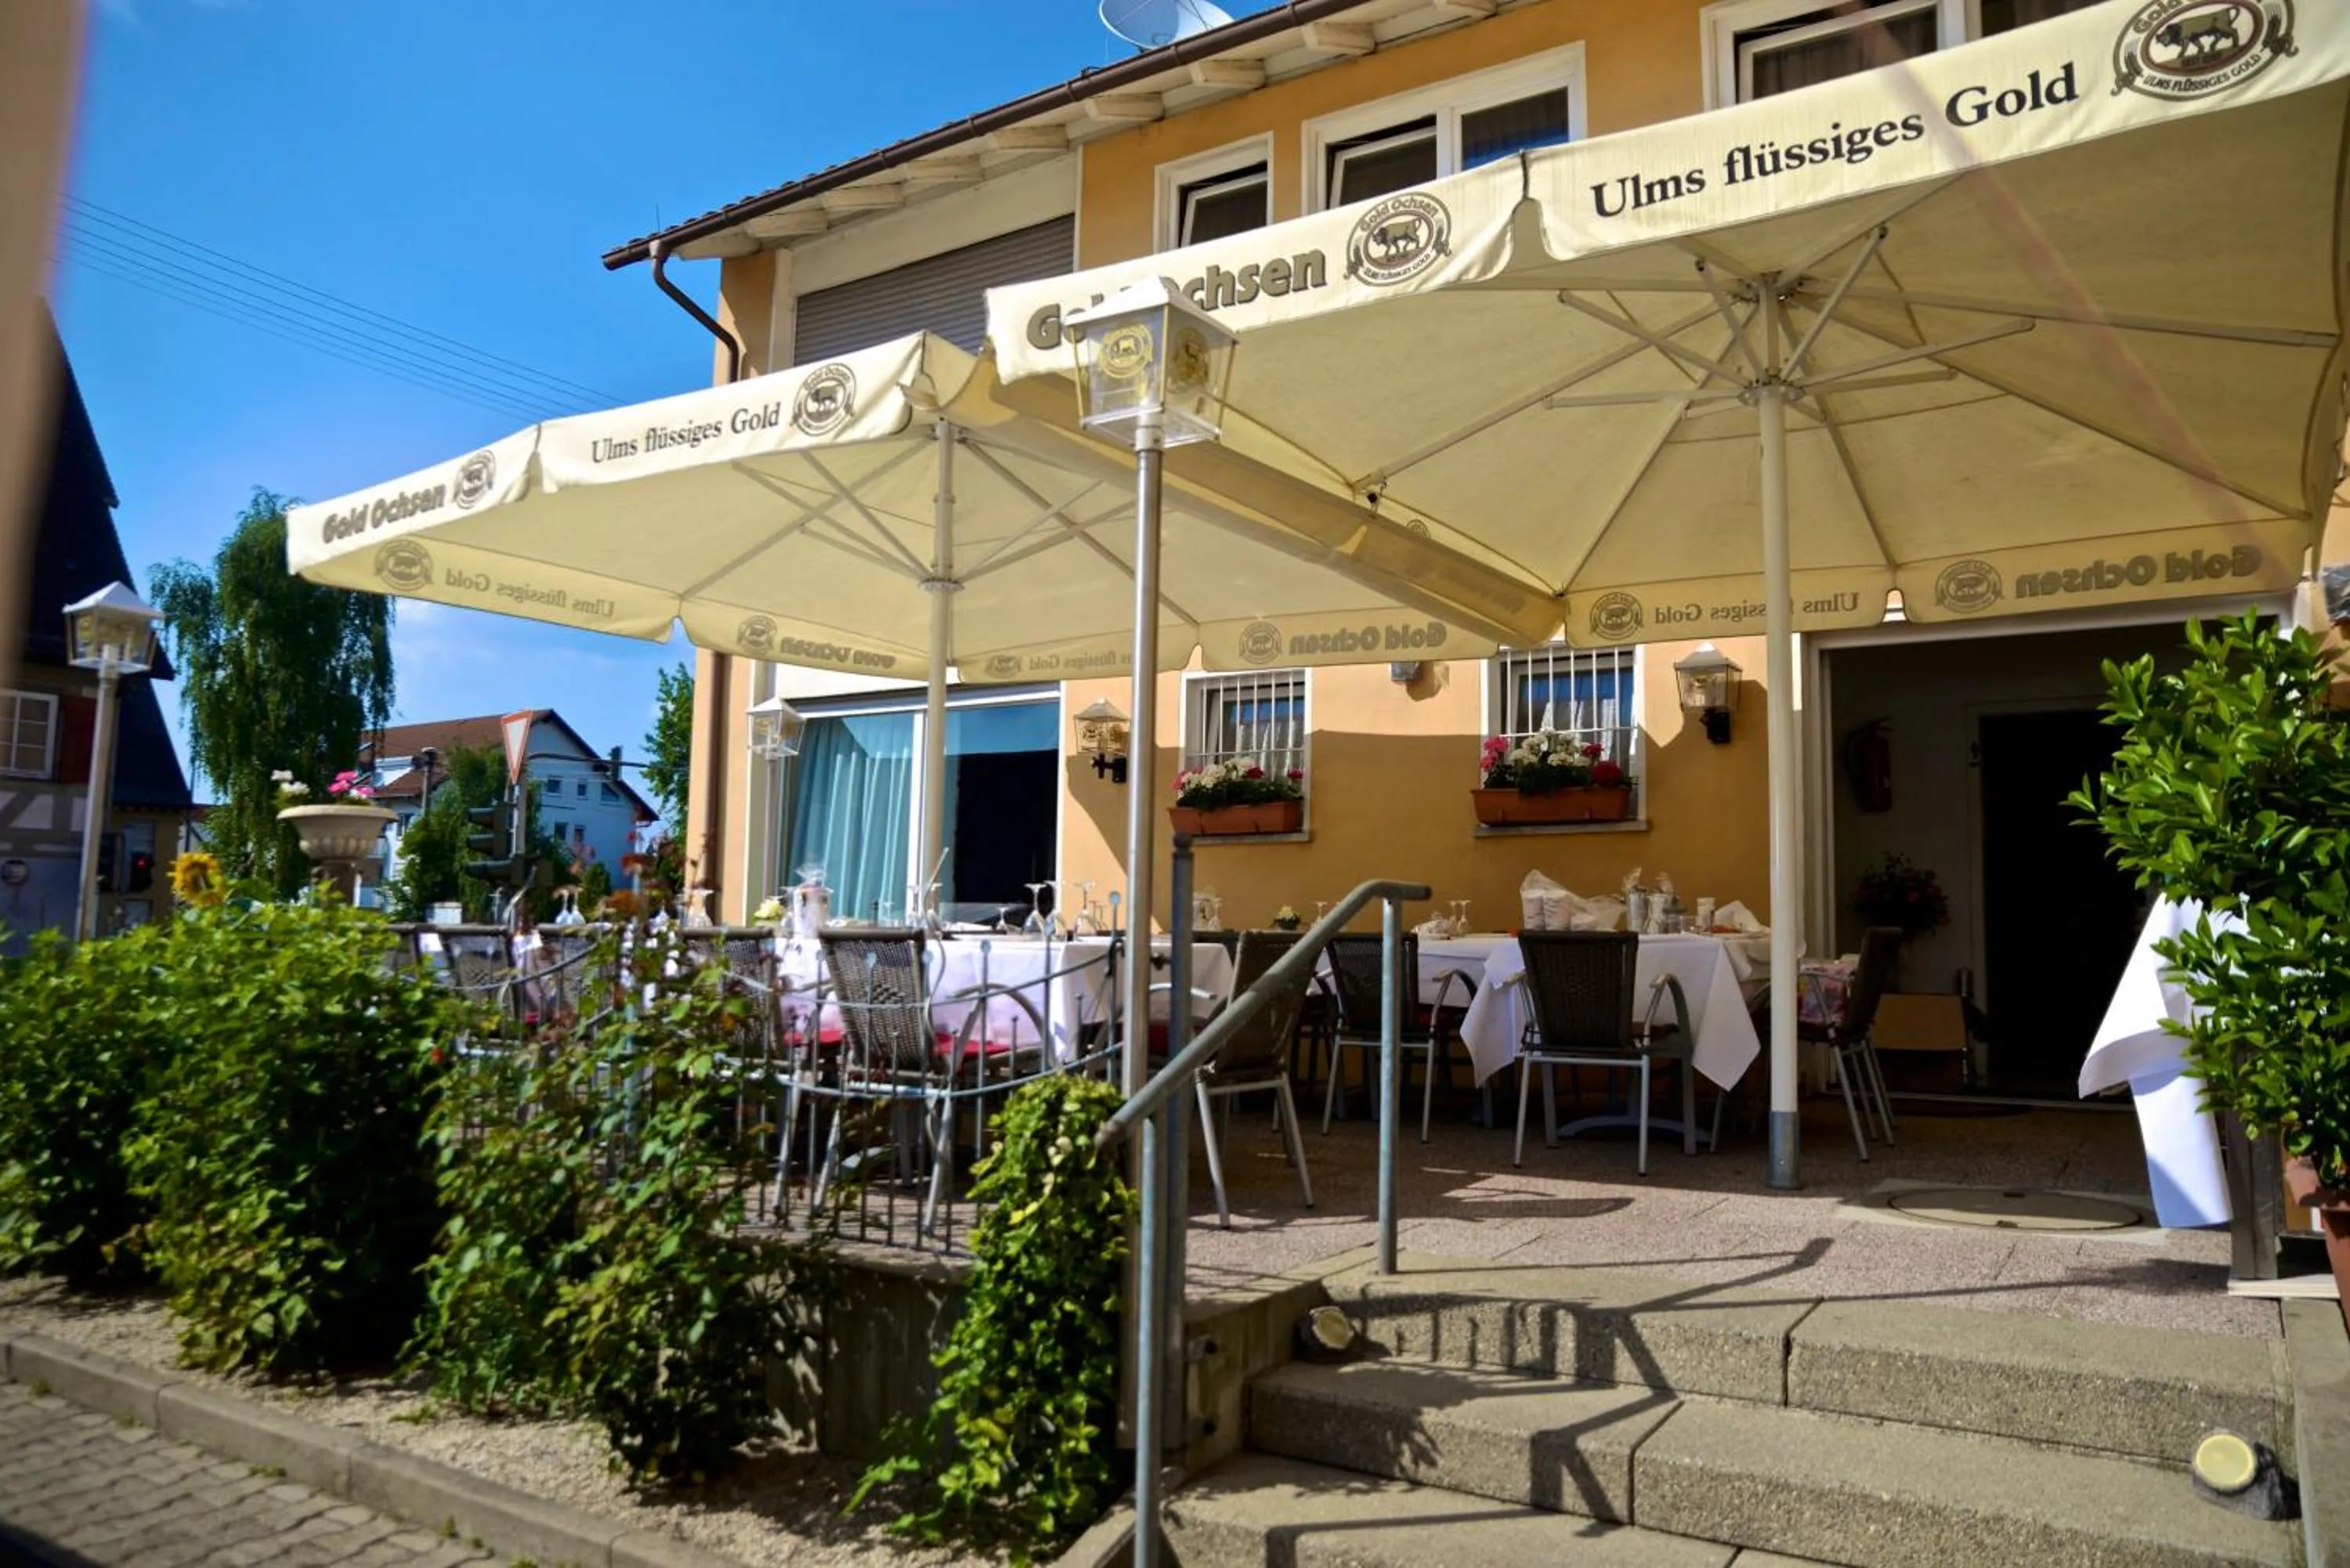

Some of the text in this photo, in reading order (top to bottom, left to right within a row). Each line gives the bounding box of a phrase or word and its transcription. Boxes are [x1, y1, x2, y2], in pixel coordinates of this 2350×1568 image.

[2231, 54, 2261, 77] GOLD
[1590, 60, 2080, 219] Ulms flüssiges Gold
[591, 438, 638, 464] Ulms
[644, 419, 723, 453] flüssiges
[731, 401, 781, 434] Gold
[323, 483, 446, 544] Gold Ochsen
